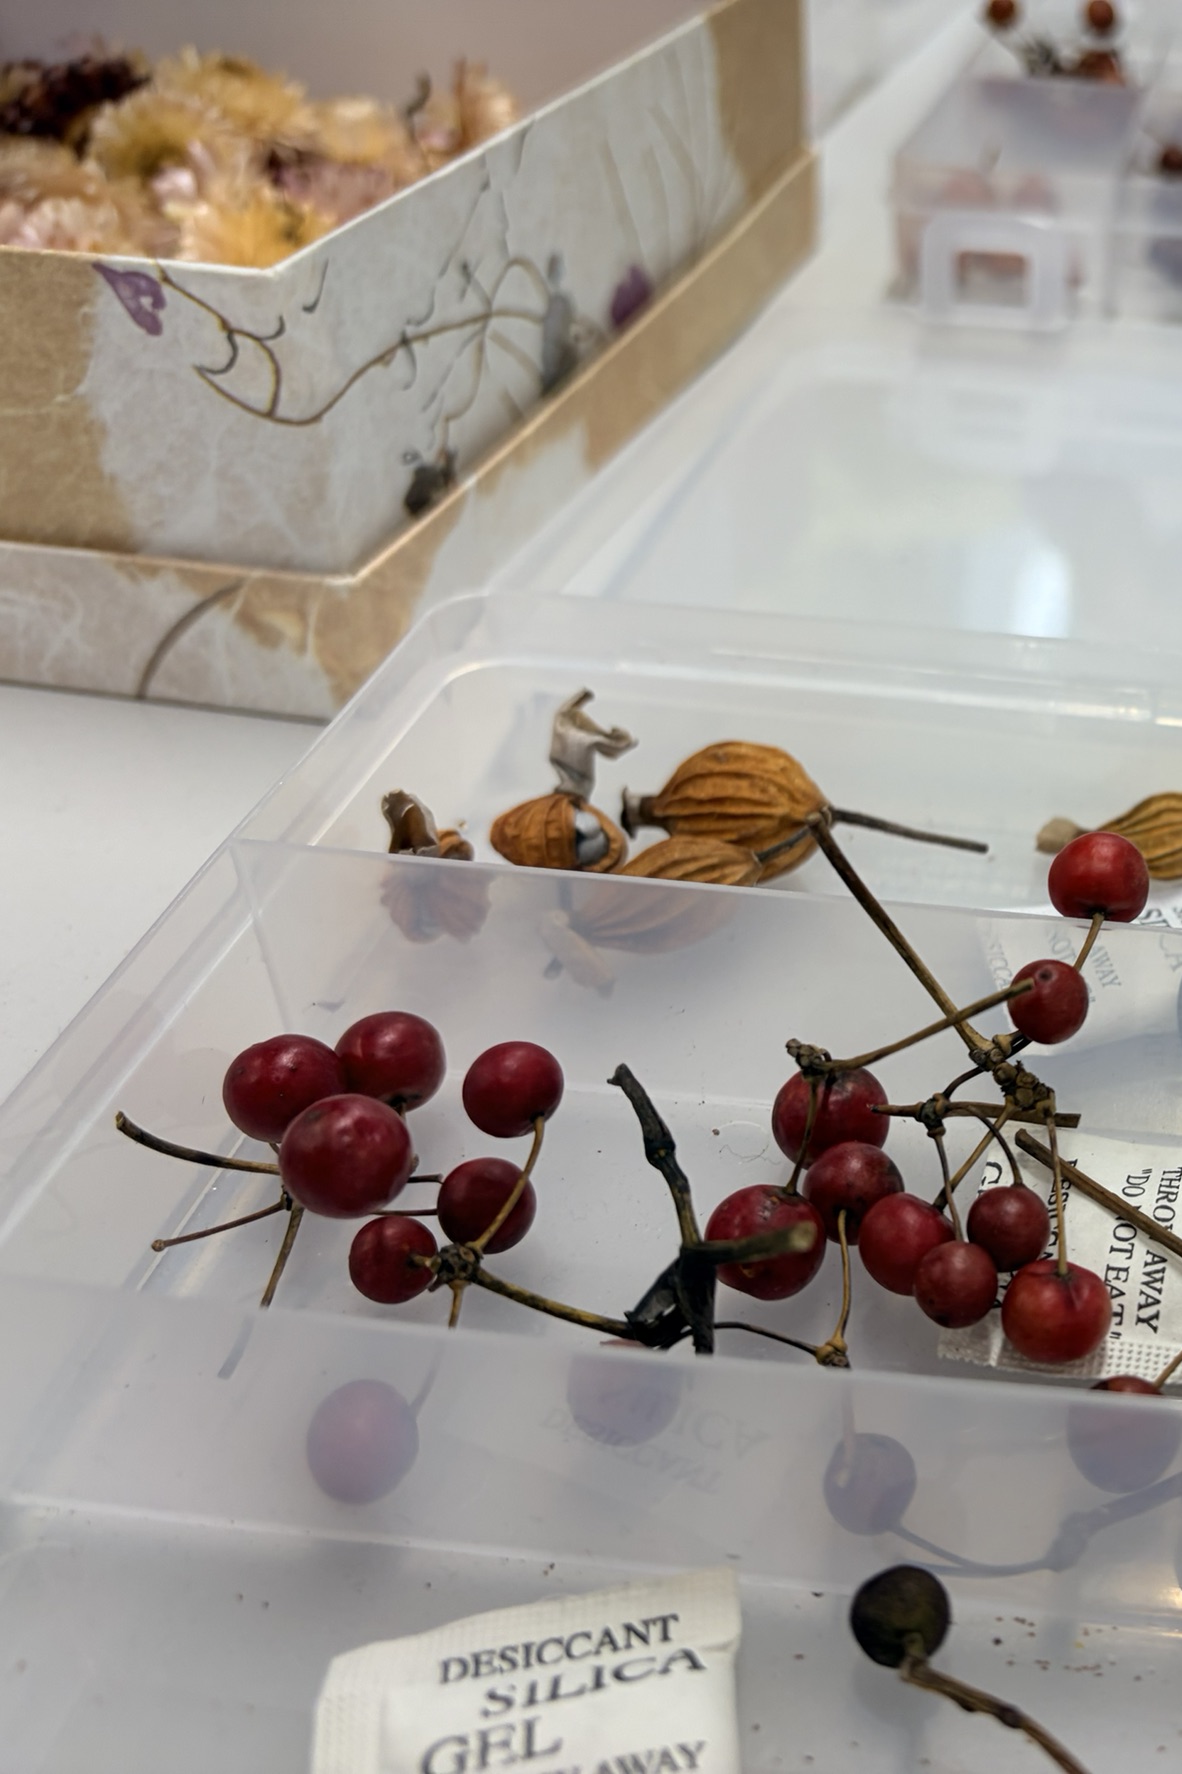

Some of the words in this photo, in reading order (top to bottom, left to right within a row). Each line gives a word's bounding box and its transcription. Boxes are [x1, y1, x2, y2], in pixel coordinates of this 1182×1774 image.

[1135, 1249, 1168, 1334] AWAY
[439, 1612, 680, 1685] DESICCANT
[479, 1647, 708, 1719] SILICA
[419, 1715, 564, 1774] GEL
